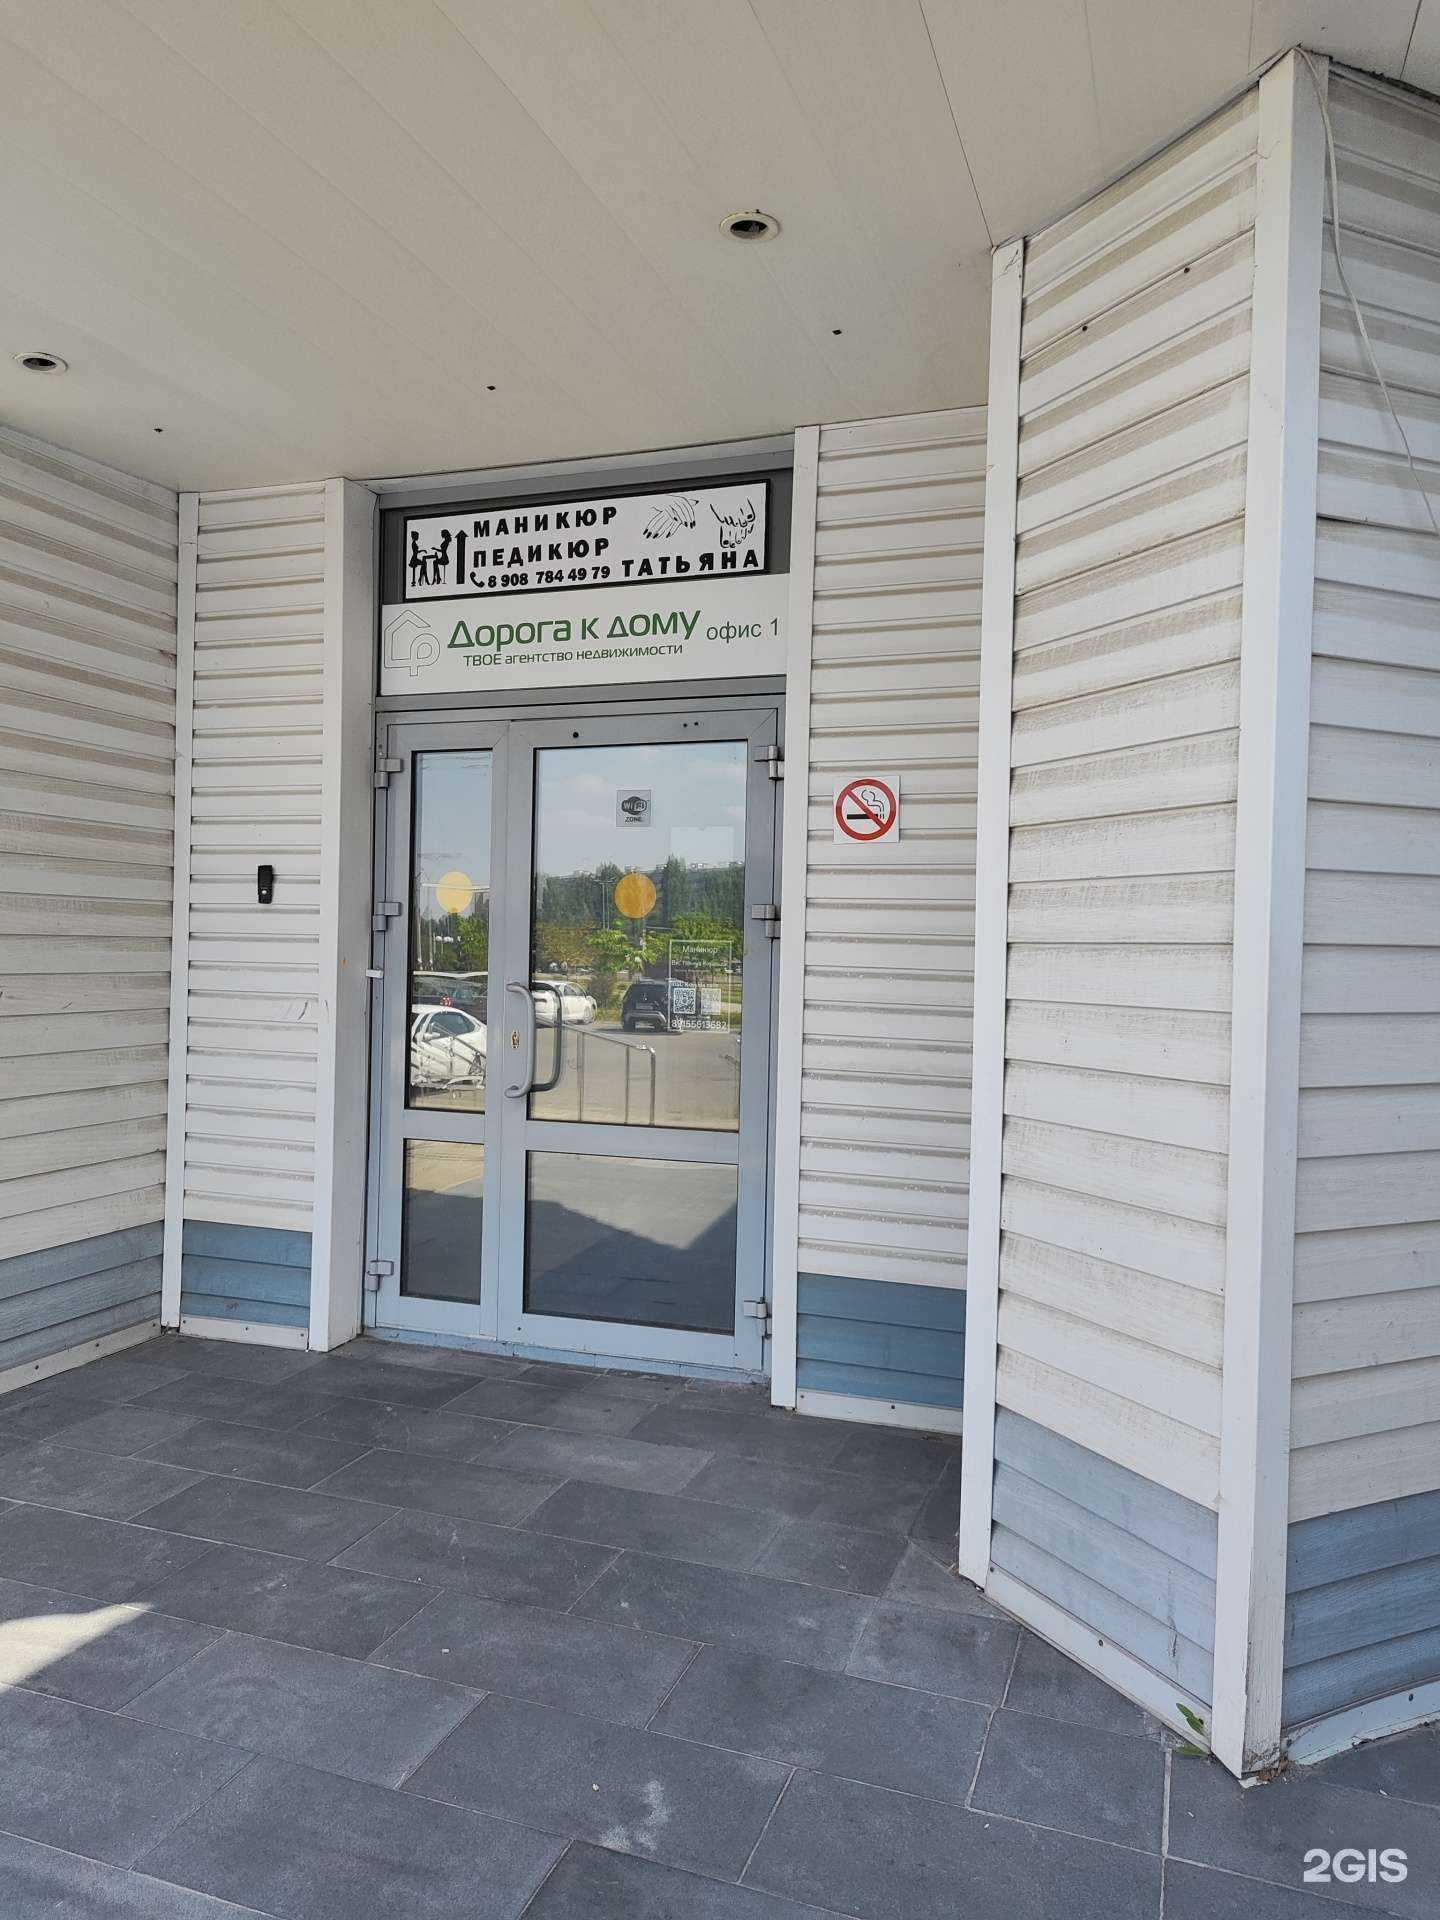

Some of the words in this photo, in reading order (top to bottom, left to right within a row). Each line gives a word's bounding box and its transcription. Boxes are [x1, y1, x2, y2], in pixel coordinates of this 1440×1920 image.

[473, 506, 617, 538] МАНИКЮР
[473, 537, 610, 568] ПЕДИКЮР
[621, 548, 760, 578] ТАТЬЯНА
[487, 575, 497, 588] 8
[500, 573, 529, 588] 908
[535, 569, 564, 584] 784
[567, 567, 587, 582] 49
[591, 565, 611, 580] 79
[447, 619, 572, 652] Дорога
[706, 621, 762, 644] офис
[770, 618, 779, 636] 1
[463, 653, 502, 667] ТВОЕ
[504, 650, 573, 665] агентство
[576, 644, 683, 661] недвижимости
